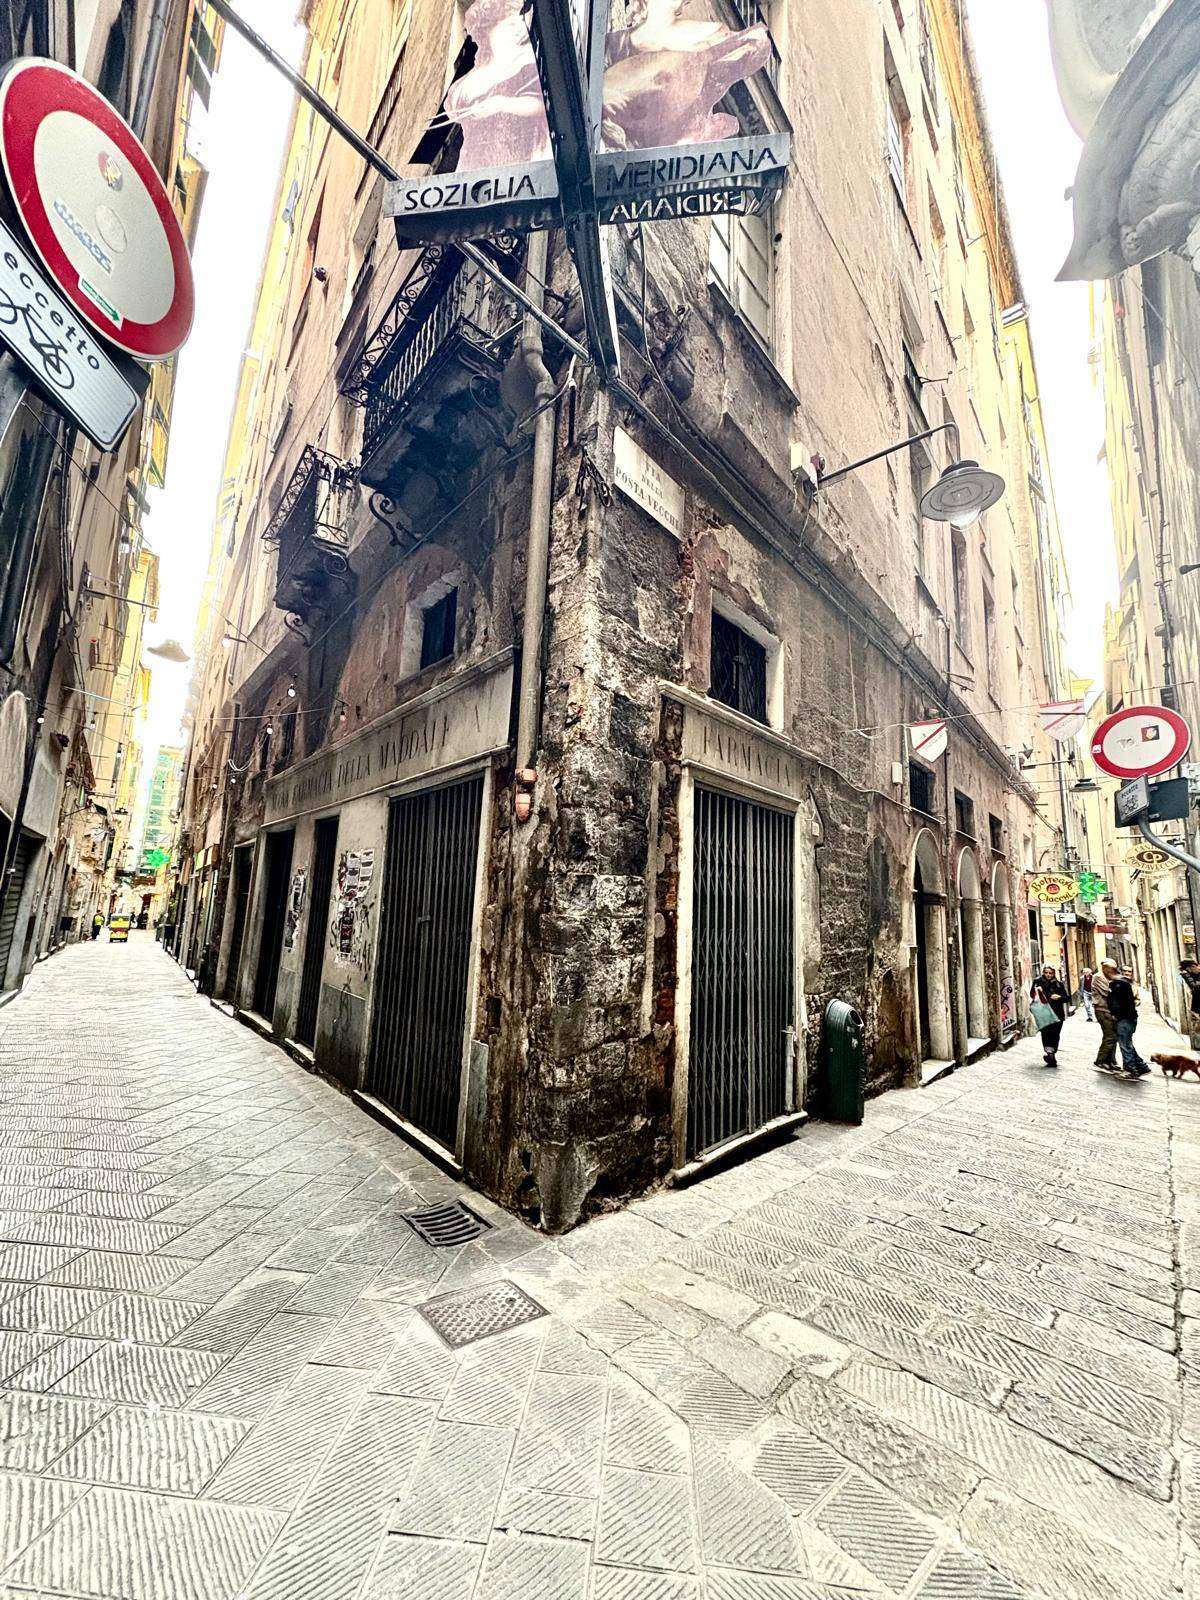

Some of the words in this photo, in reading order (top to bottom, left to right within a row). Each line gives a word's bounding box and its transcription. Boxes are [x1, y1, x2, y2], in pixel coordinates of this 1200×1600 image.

[607, 147, 778, 192] MERIDIANA
[404, 174, 536, 211] SOZIGLIA
[4, 251, 100, 370] eccetto
[615, 466, 645, 499] POSTA
[337, 753, 371, 788] DELLA
